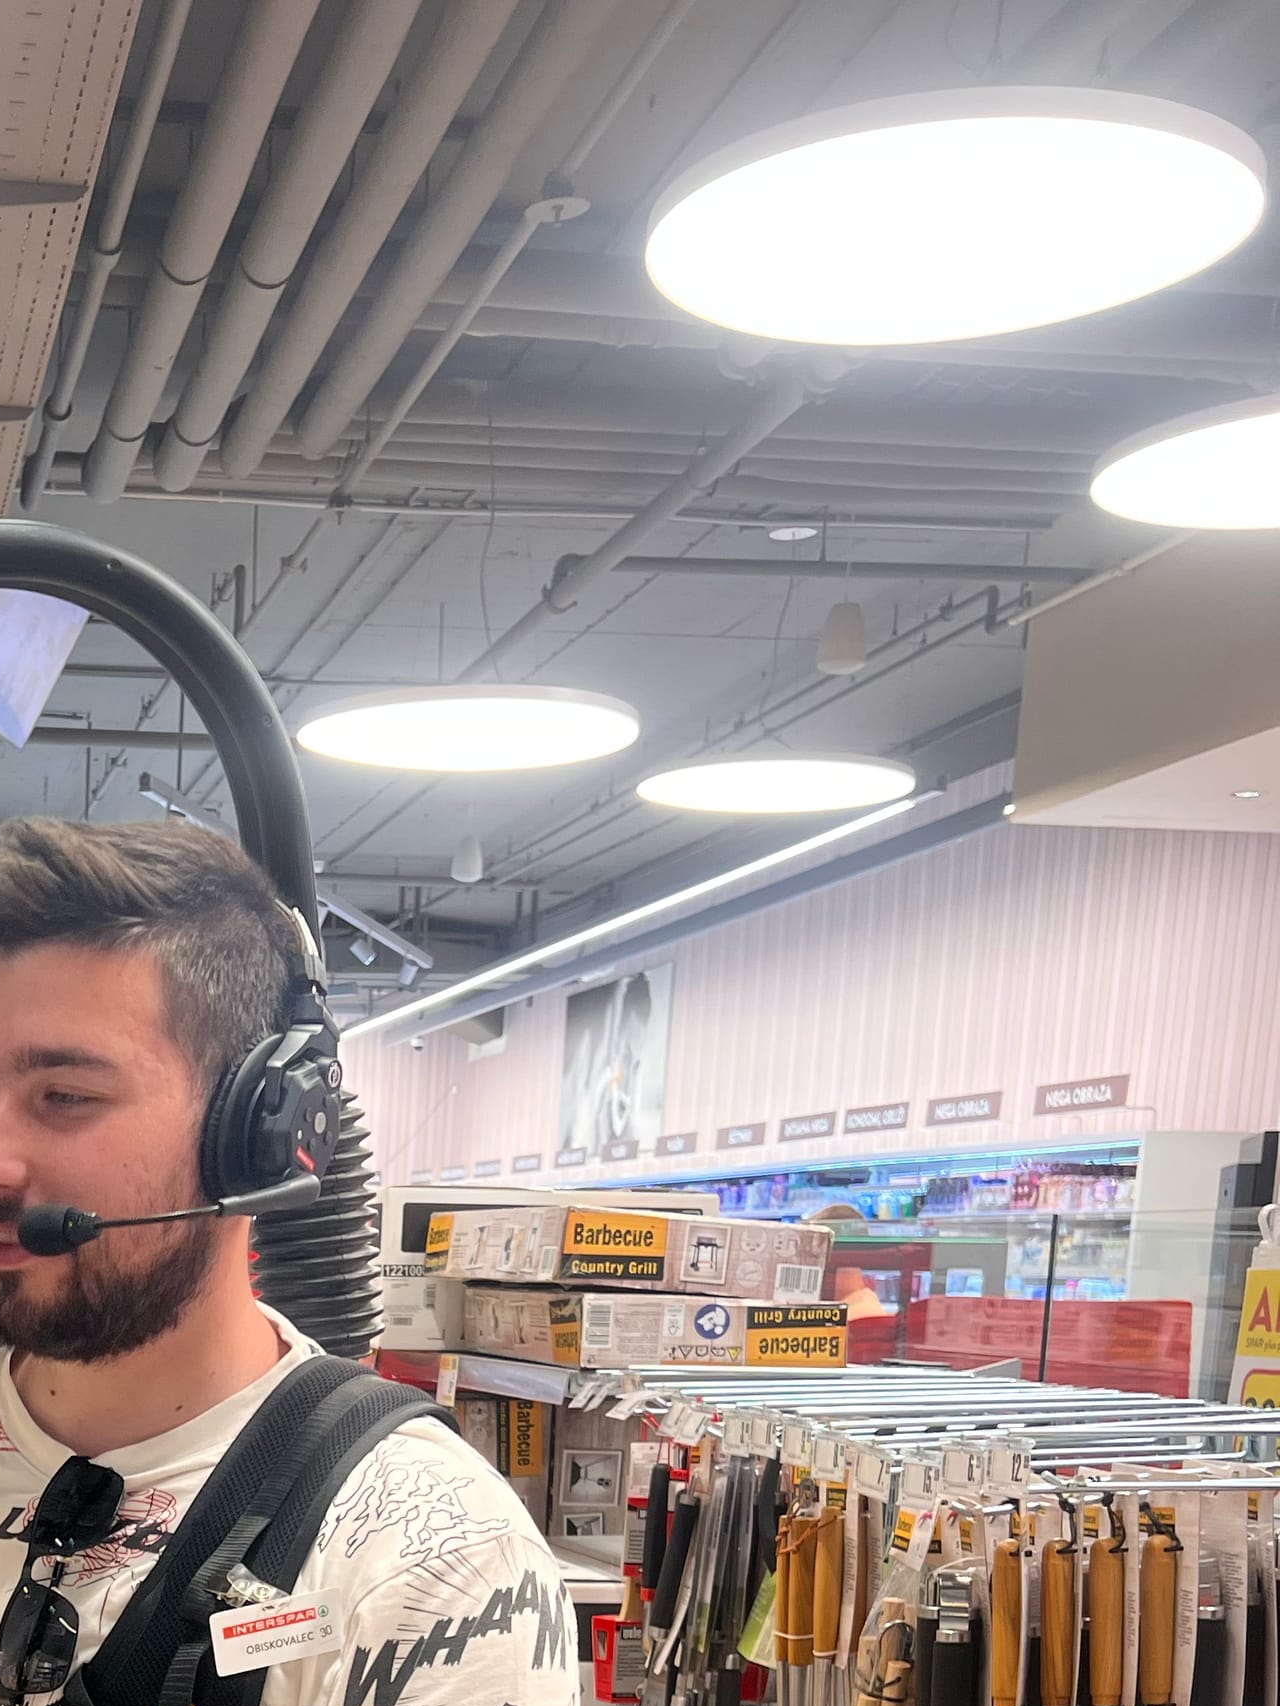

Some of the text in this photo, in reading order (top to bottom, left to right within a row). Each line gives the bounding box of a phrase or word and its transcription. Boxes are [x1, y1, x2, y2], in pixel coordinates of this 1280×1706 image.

[573, 1222, 655, 1248] Barbecue
[571, 1259, 658, 1276] Country Grill
[753, 1308, 841, 1325] Country Grill
[759, 1335, 840, 1359] Barbecue
[517, 1399, 535, 1468] Barbecue
[232, 1610, 315, 1637] INTERSPAR
[246, 1624, 333, 1655] OBISKOVALEC 30
